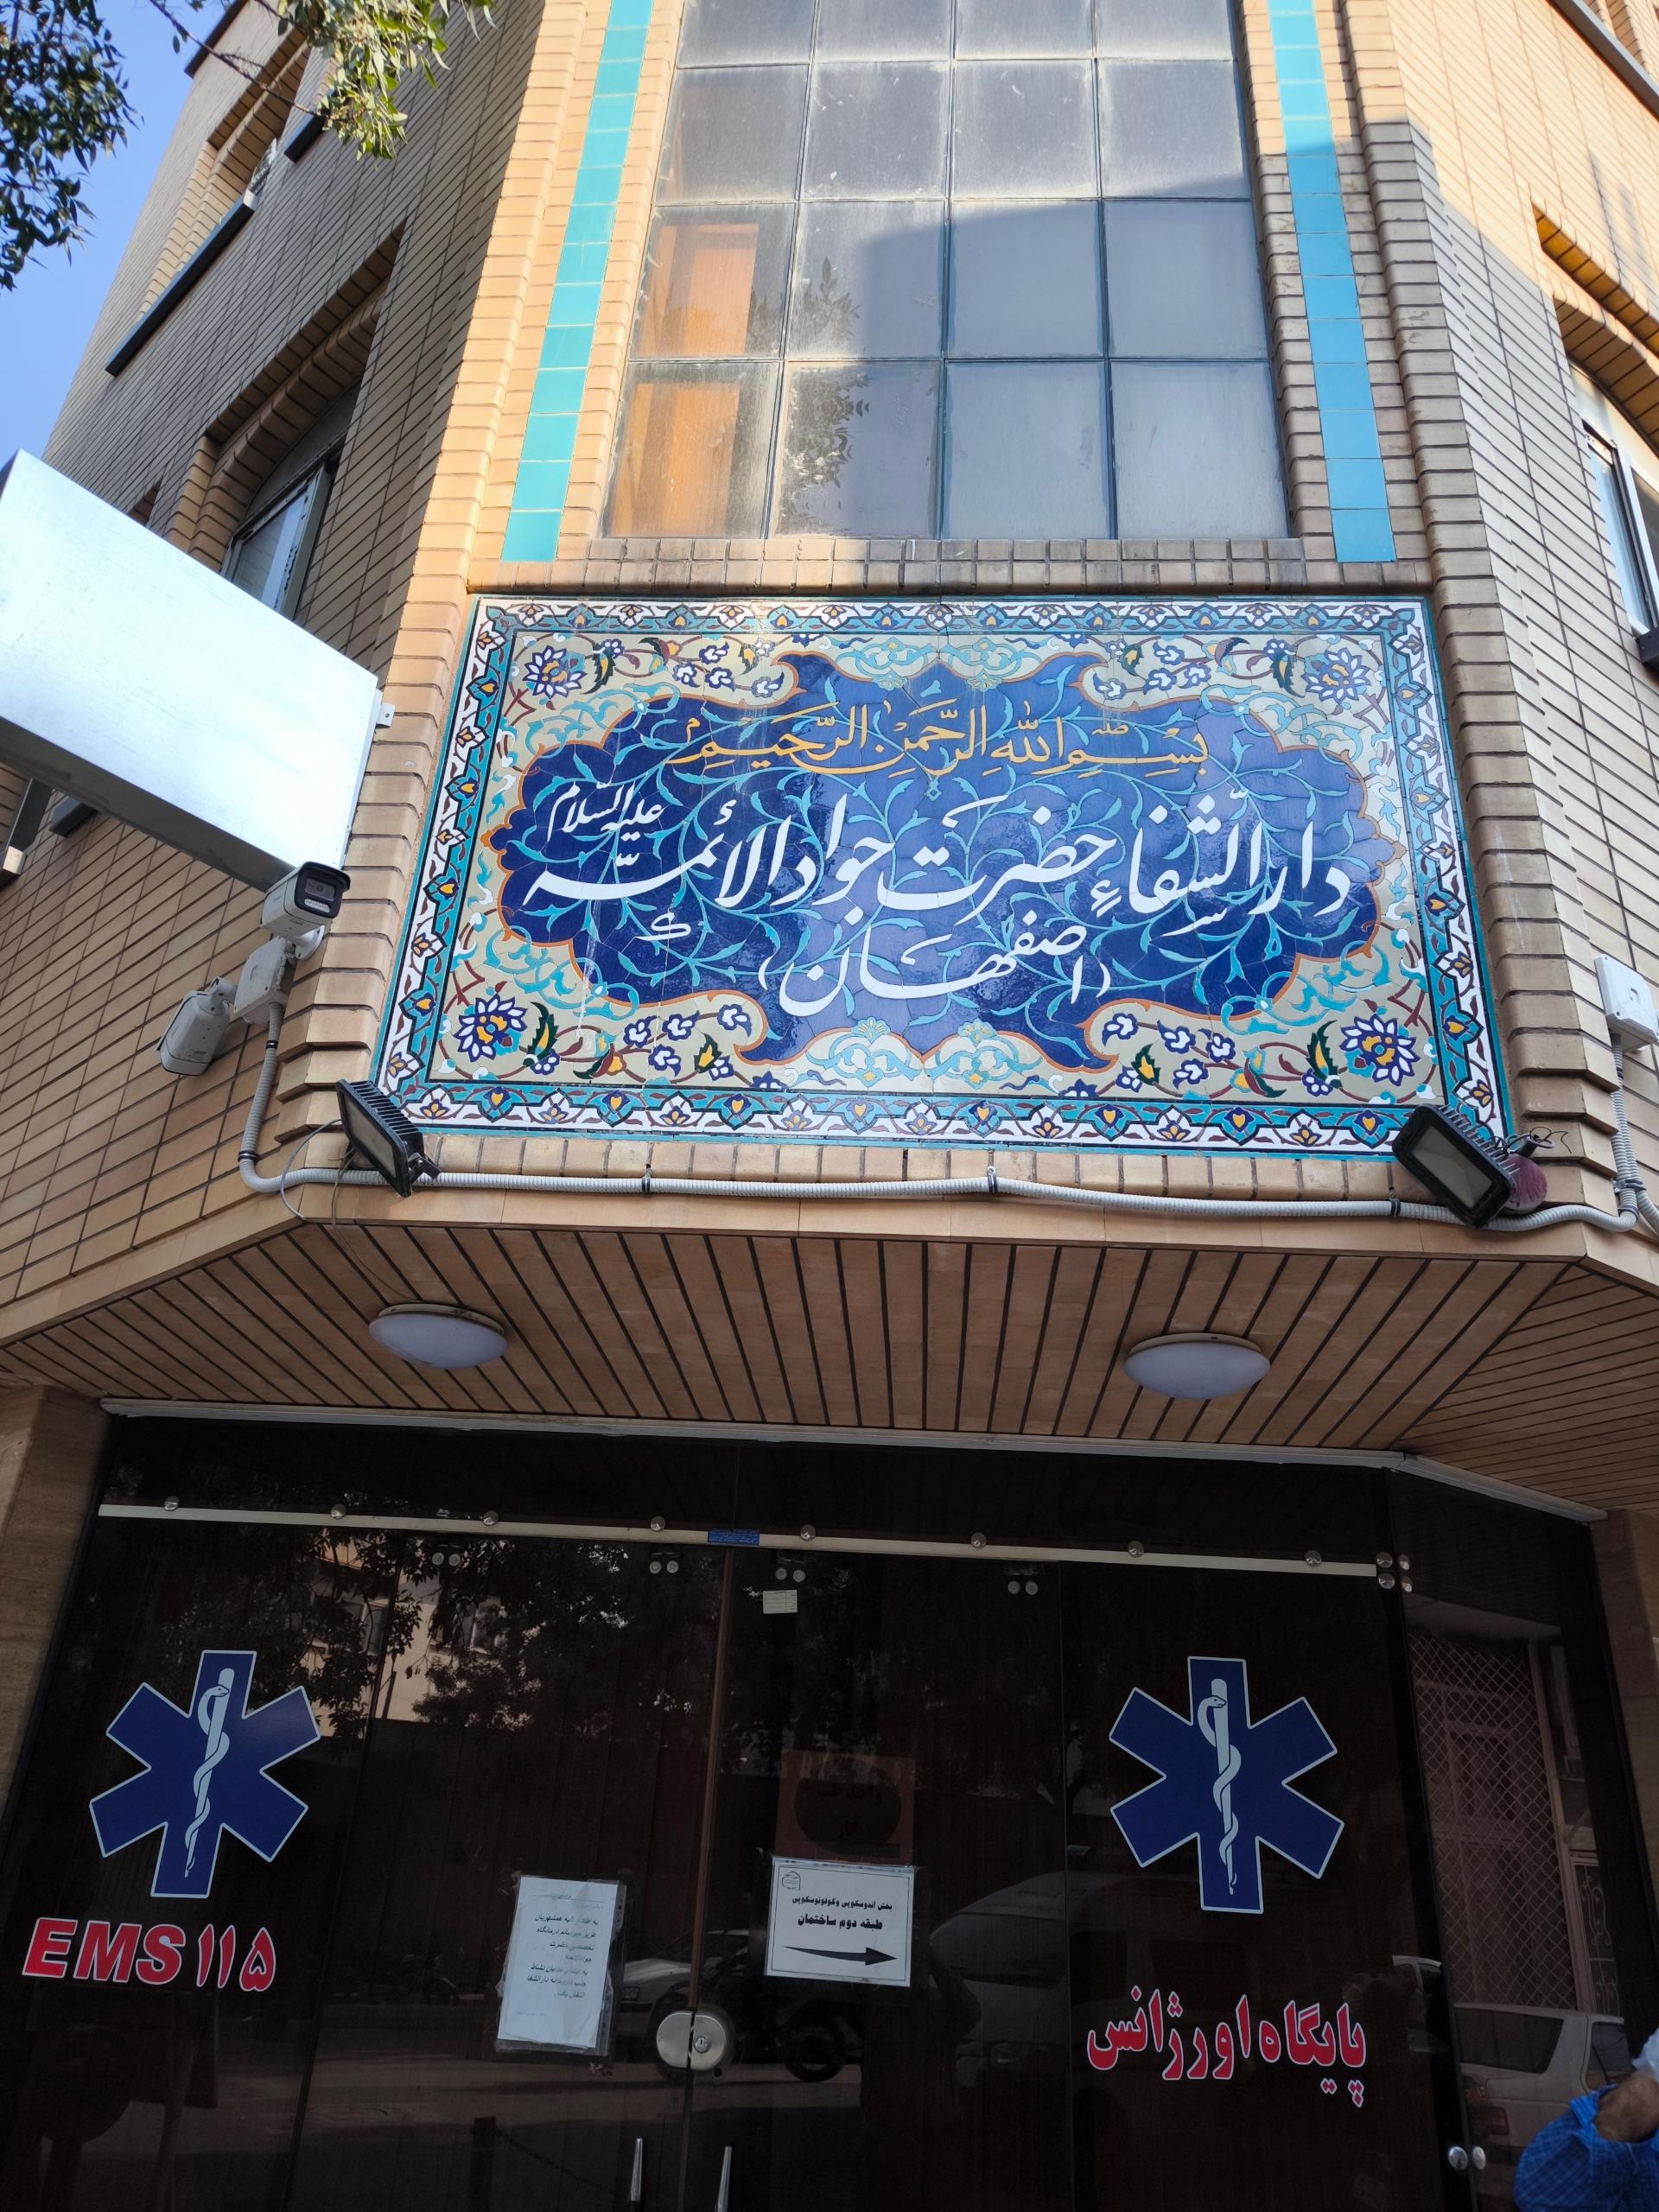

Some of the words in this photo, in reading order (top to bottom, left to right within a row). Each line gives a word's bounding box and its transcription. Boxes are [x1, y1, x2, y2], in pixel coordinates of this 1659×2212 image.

[877, 1903, 893, 1912] بخش
[798, 1913, 836, 1926] ساختمان
[839, 1919, 857, 1929] دوم
[860, 1918, 883, 1931] طبقه
[22, 1917, 186, 1985] EMS
[196, 1923, 276, 1992] ۱۱۵
[1087, 1985, 1251, 2080] اورژانس
[1259, 2000, 1367, 2107] پایگاه
